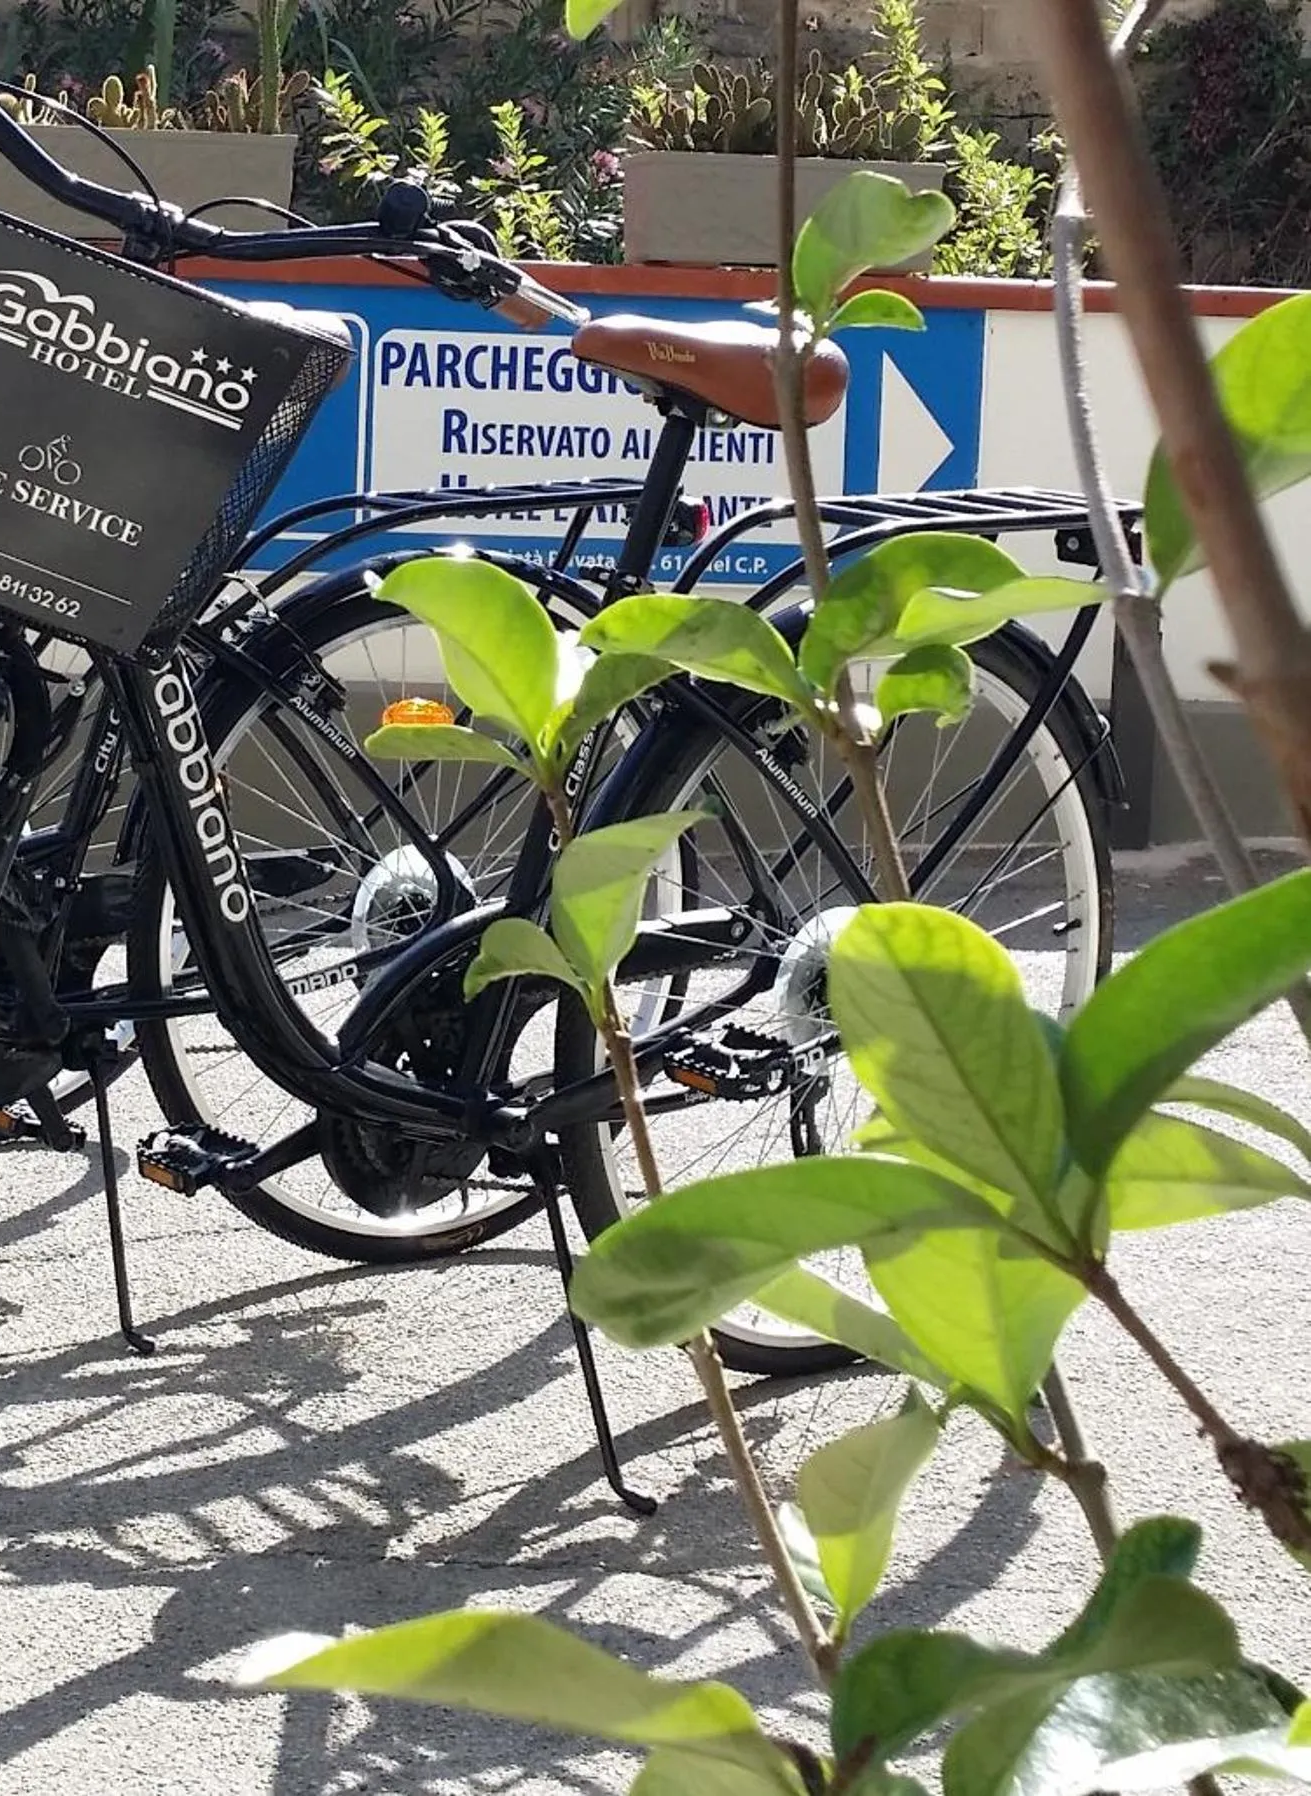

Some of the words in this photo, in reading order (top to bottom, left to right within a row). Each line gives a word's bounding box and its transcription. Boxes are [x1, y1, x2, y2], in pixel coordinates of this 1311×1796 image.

[29, 341, 142, 400] HOTEL
[442, 408, 611, 459] RISERVATO
[621, 428, 650, 461] AI
[688, 432, 774, 464] IENTI
[12, 478, 144, 547] SERVICE
[660, 554, 683, 571] 61
[707, 555, 730, 573] el
[735, 556, 768, 574] C.P.
[95, 731, 118, 773] City
[289, 696, 356, 759] Aluminium
[150, 660, 250, 923] abbiano
[565, 726, 596, 797] Class
[755, 748, 818, 819] Aluminium
[288, 962, 358, 996] MANO
